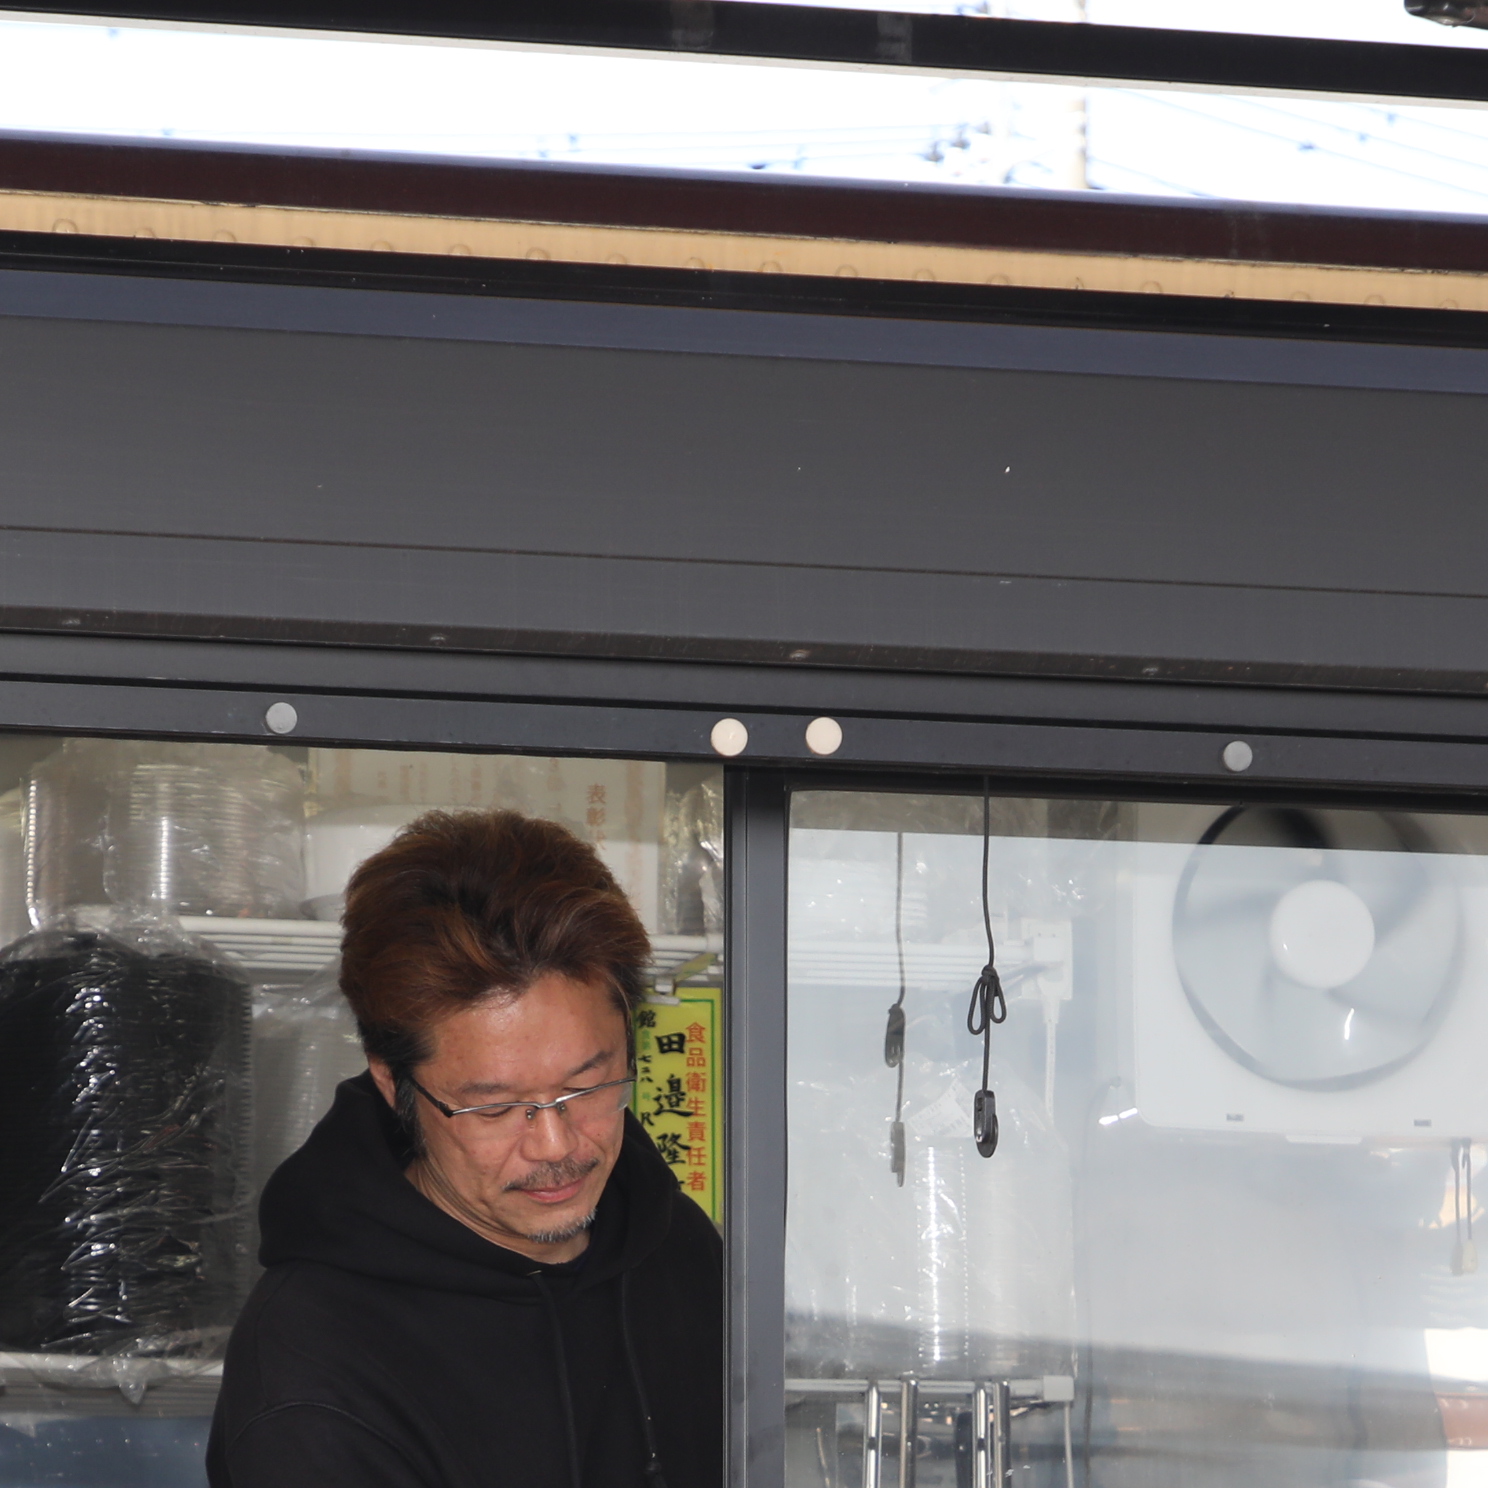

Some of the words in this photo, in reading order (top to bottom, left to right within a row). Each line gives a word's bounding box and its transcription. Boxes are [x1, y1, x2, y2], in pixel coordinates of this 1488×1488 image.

[685, 1021, 708, 1192] 食品衛生責任者
